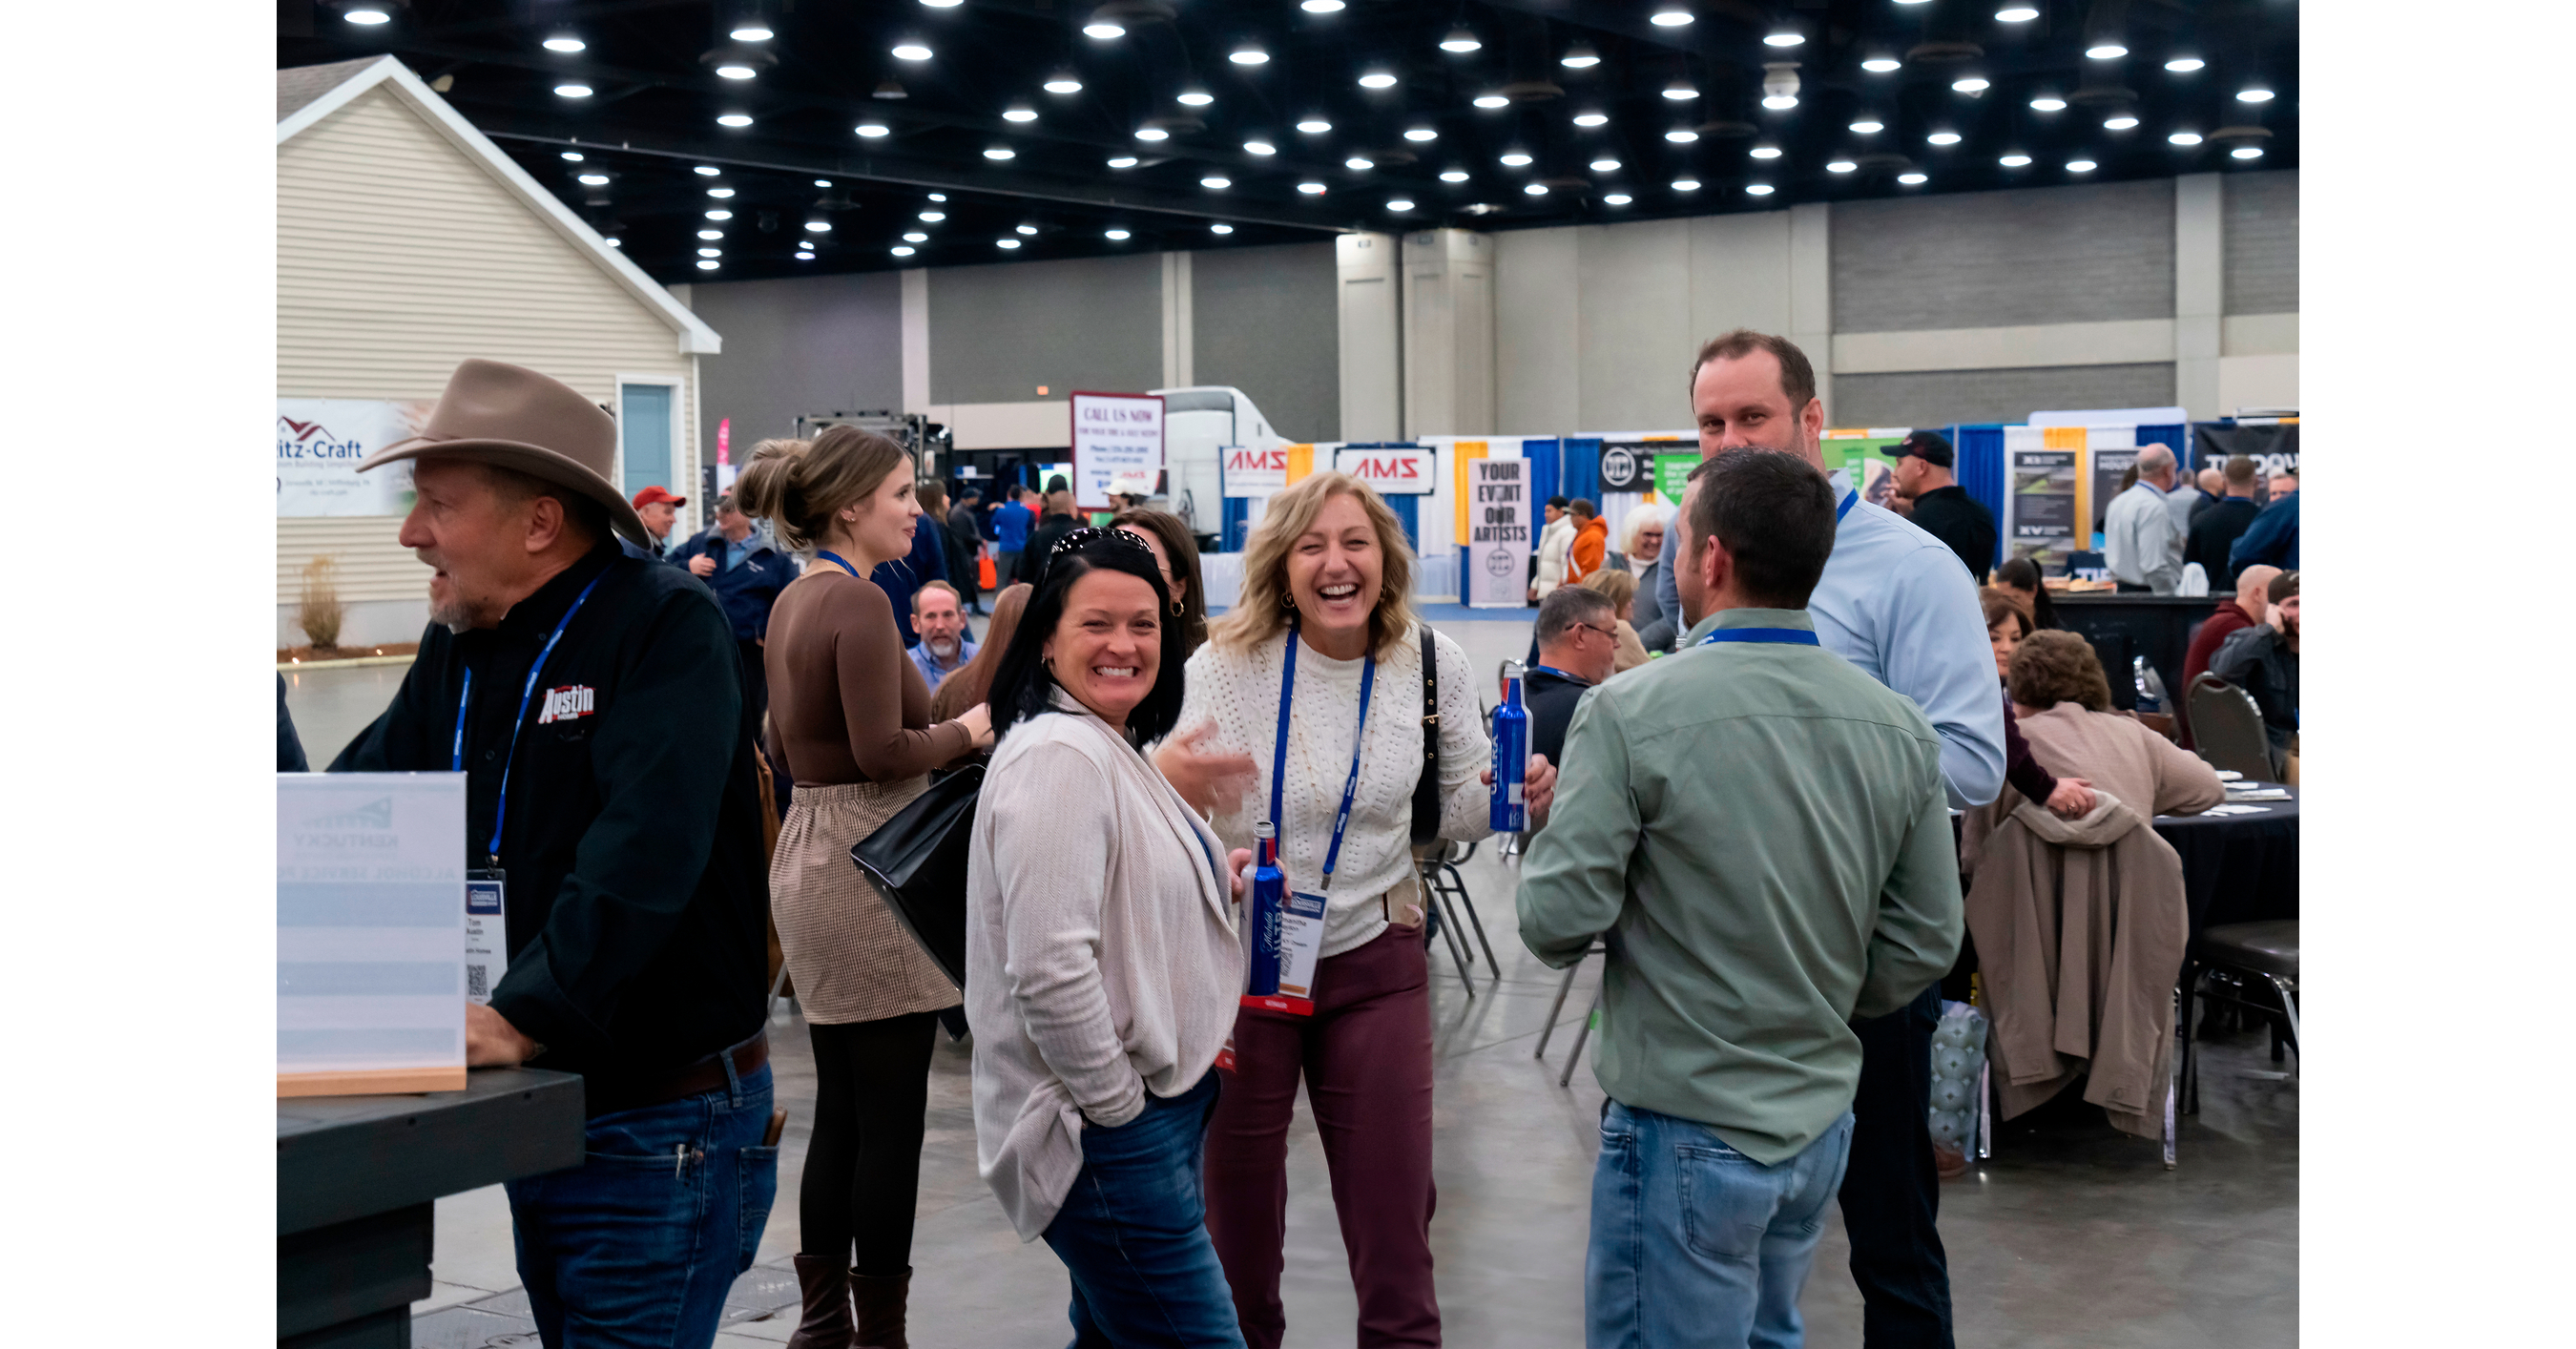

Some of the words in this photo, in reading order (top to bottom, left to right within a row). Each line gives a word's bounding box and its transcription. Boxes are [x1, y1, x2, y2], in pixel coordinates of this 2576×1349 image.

[1112, 409, 1127, 422] US
[1131, 410, 1153, 422] NOW
[277, 440, 363, 458] itz-Craft
[1228, 451, 1287, 470] AMS
[1354, 459, 1419, 478] AMS
[1480, 464, 1520, 481] YOUR
[1485, 507, 1515, 525] OUR
[1474, 527, 1527, 542] ARTISTS
[539, 684, 594, 724] Austin
